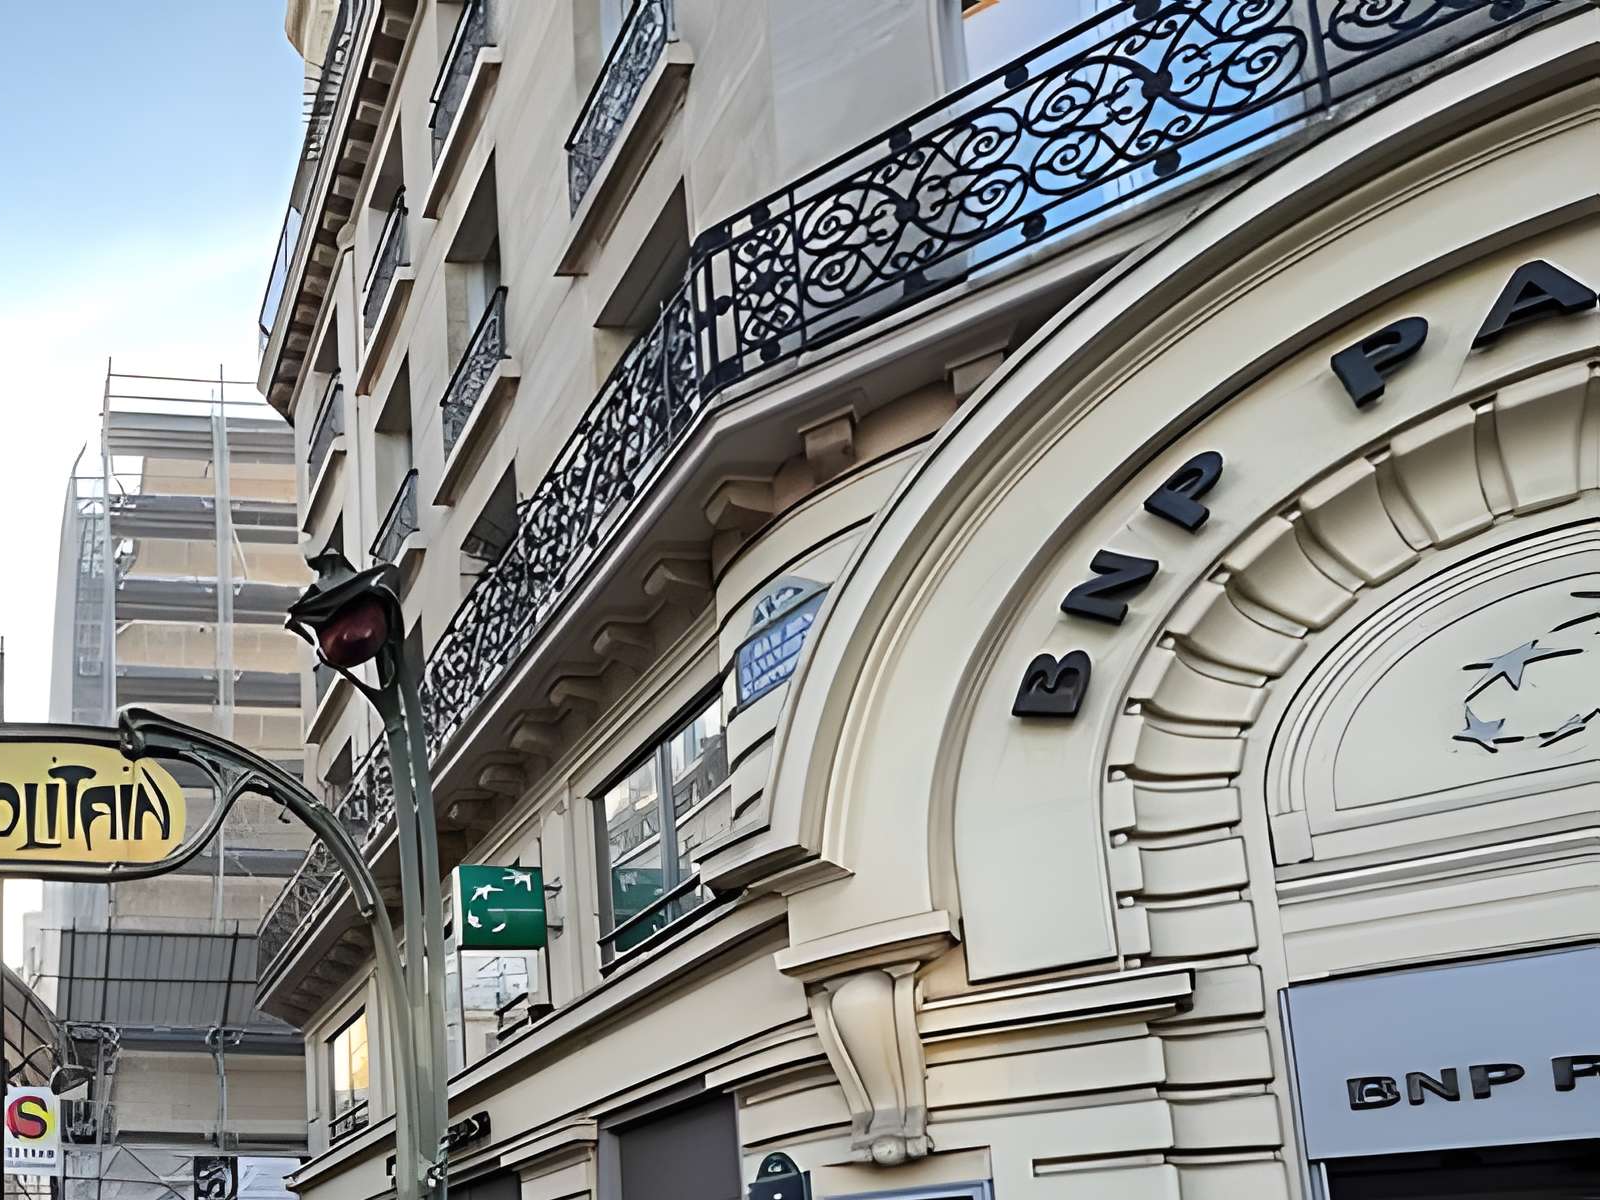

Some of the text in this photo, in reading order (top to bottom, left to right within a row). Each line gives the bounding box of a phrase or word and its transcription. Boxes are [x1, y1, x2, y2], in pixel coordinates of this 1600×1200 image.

[1011, 450, 1223, 718] BNP
[1330, 259, 1600, 409] PA
[1346, 1062, 1525, 1111] BNP
